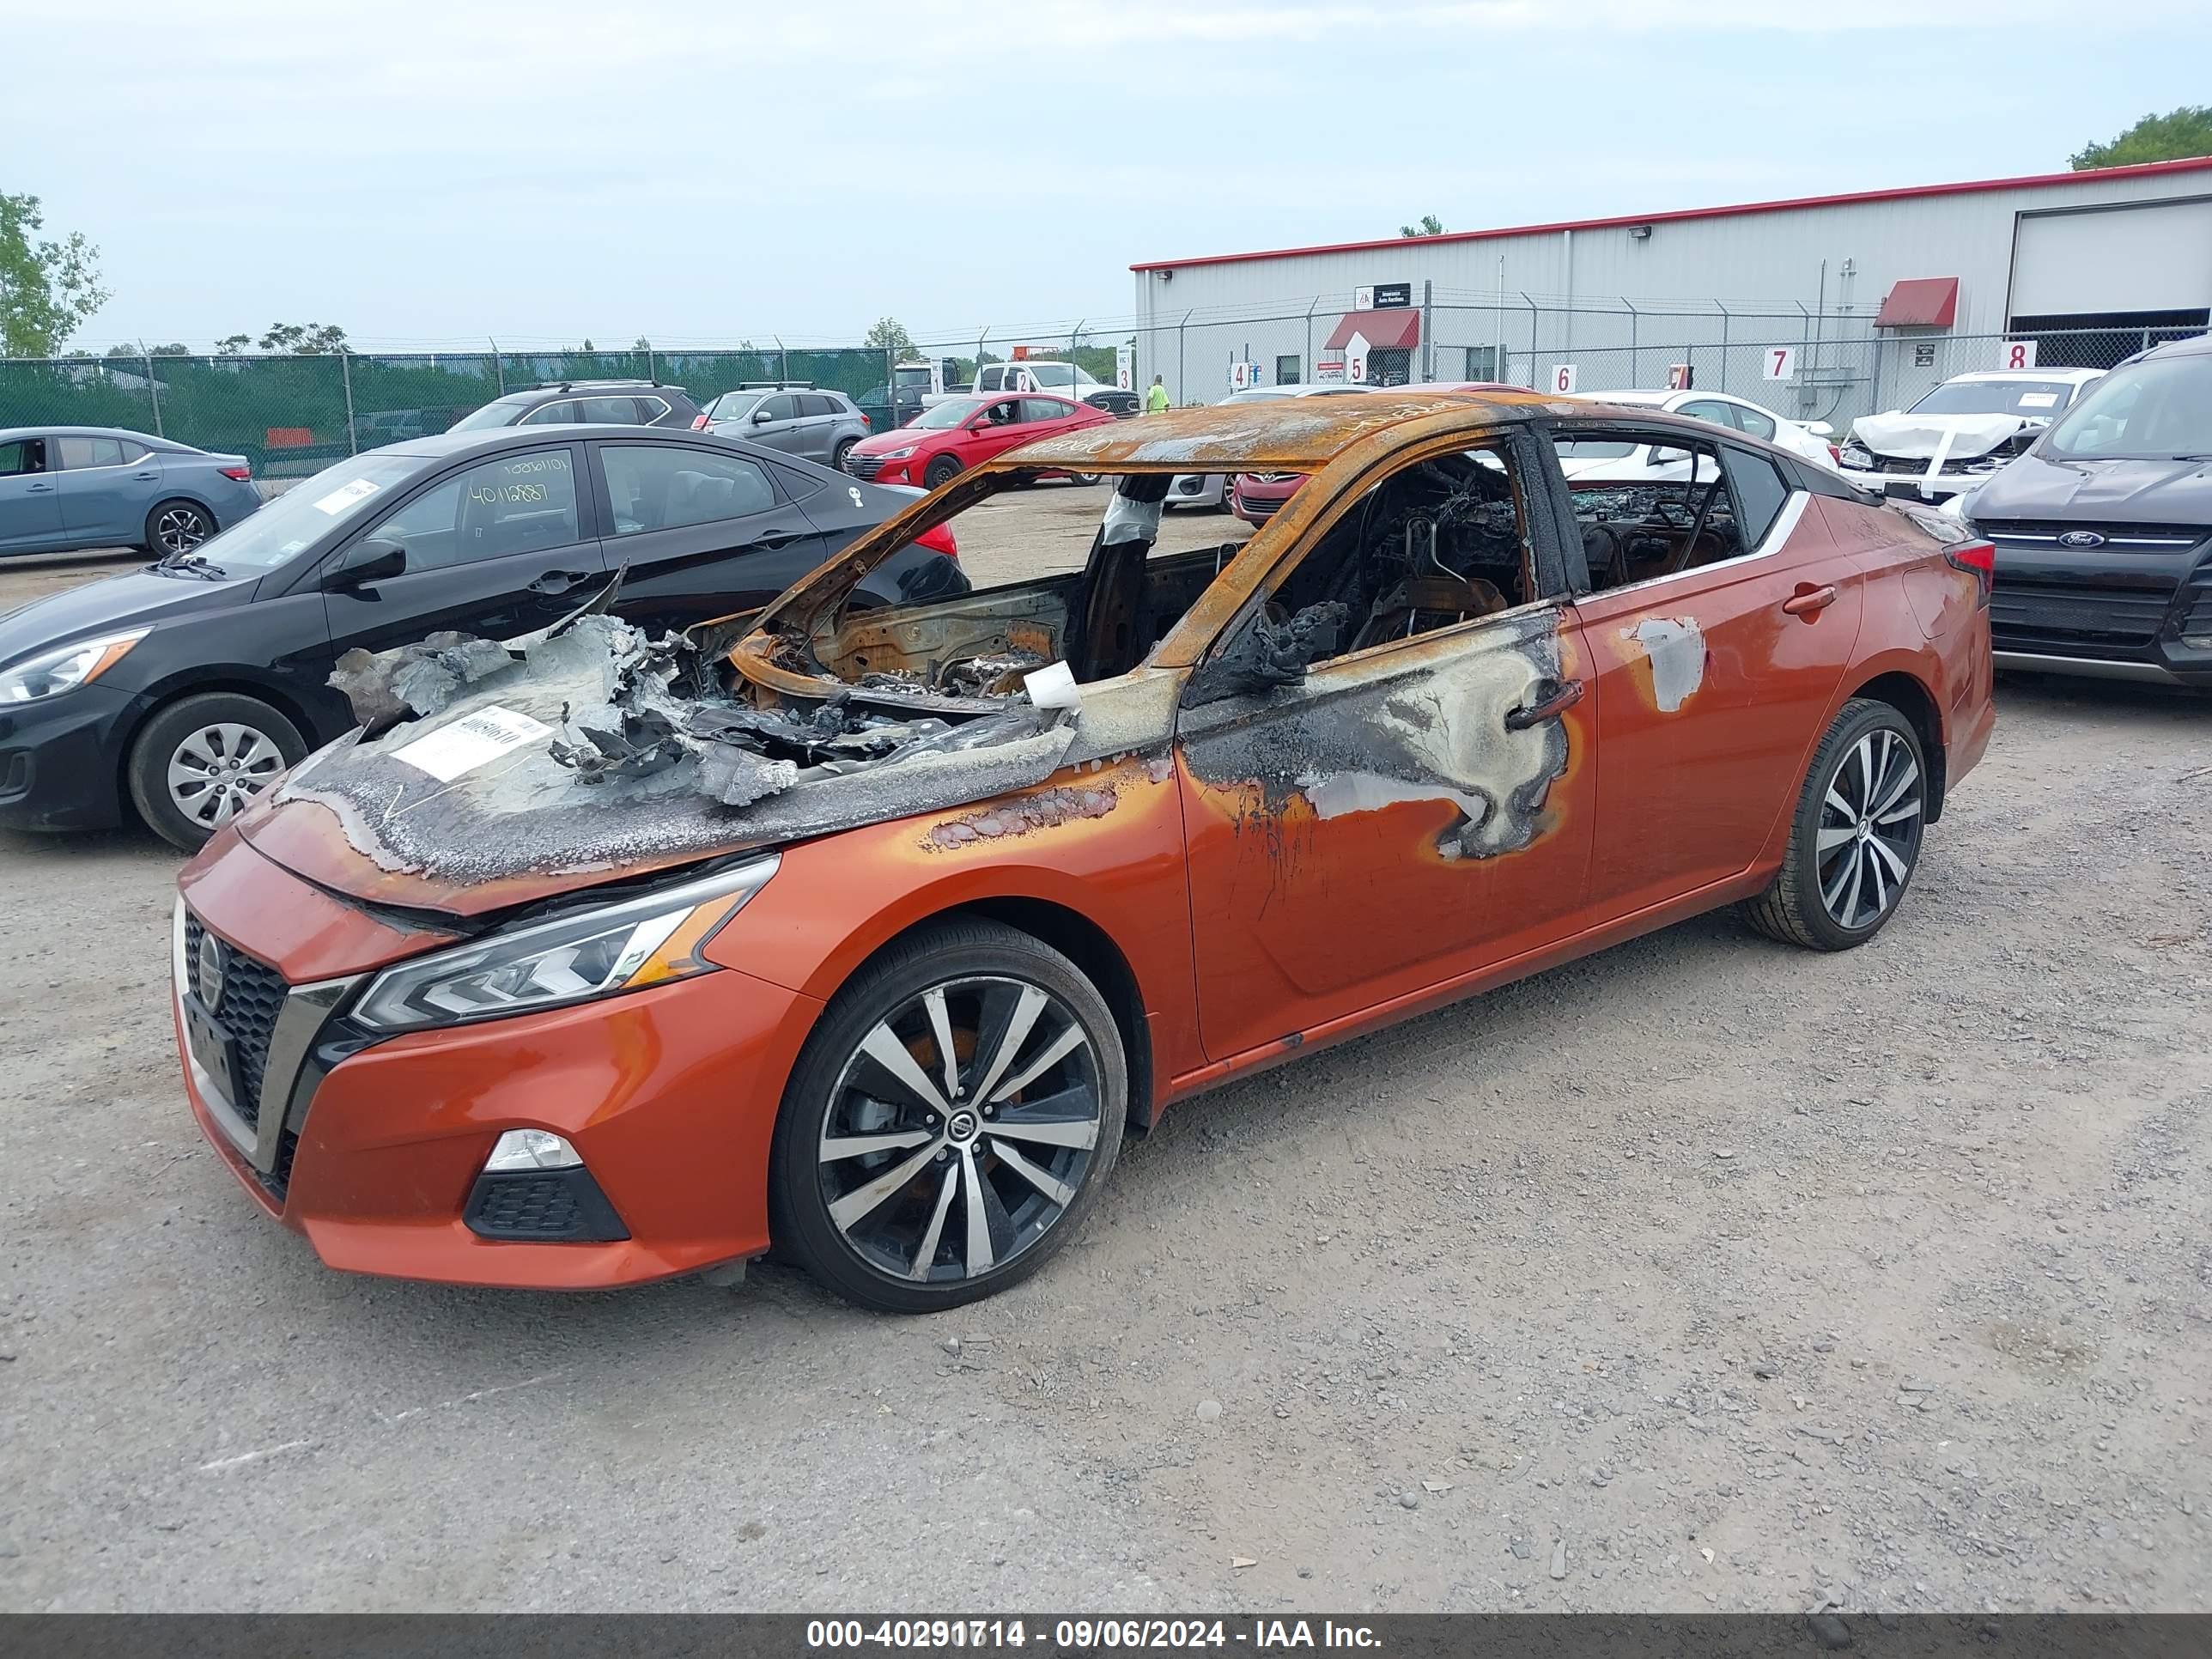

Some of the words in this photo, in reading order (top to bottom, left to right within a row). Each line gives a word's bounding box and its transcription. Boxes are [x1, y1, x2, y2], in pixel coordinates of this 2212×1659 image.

[1773, 350, 1787, 376] 7
[2009, 344, 2026, 368] 8
[1121, 370, 1128, 389] 3
[1235, 365, 1244, 386] 4
[1352, 358, 1361, 380] 5
[1558, 367, 1570, 392] 6
[1020, 374, 1027, 392] 2
[469, 483, 549, 506] 40112887
[2067, 533, 2094, 544] Ford
